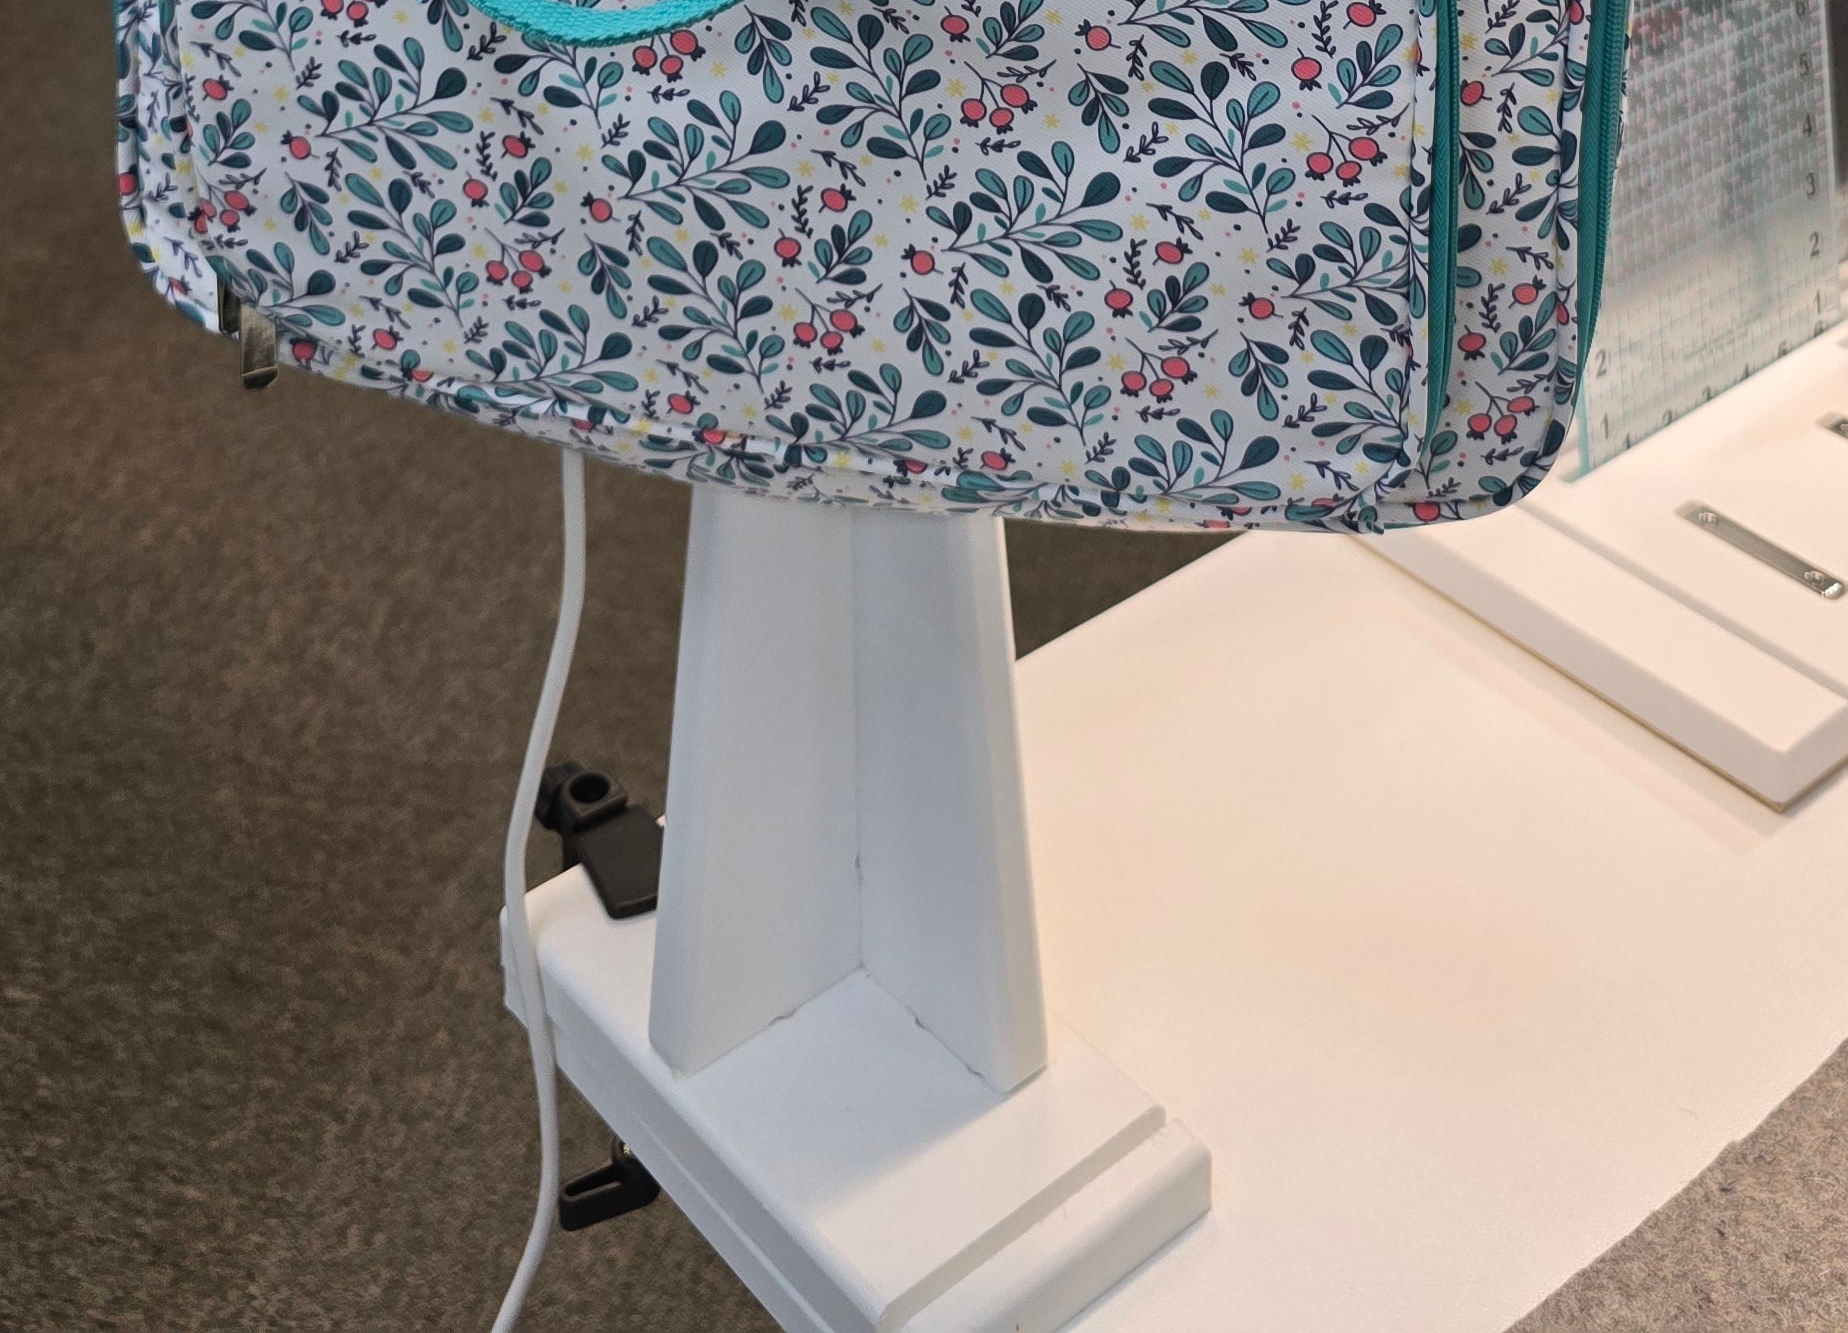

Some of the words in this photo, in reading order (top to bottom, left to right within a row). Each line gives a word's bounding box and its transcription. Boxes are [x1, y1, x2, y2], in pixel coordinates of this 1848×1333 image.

[1803, 113, 1813, 138] 4
[1806, 172, 1817, 198] 3
[1809, 231, 1820, 257] 2
[1595, 349, 1607, 378] 2
